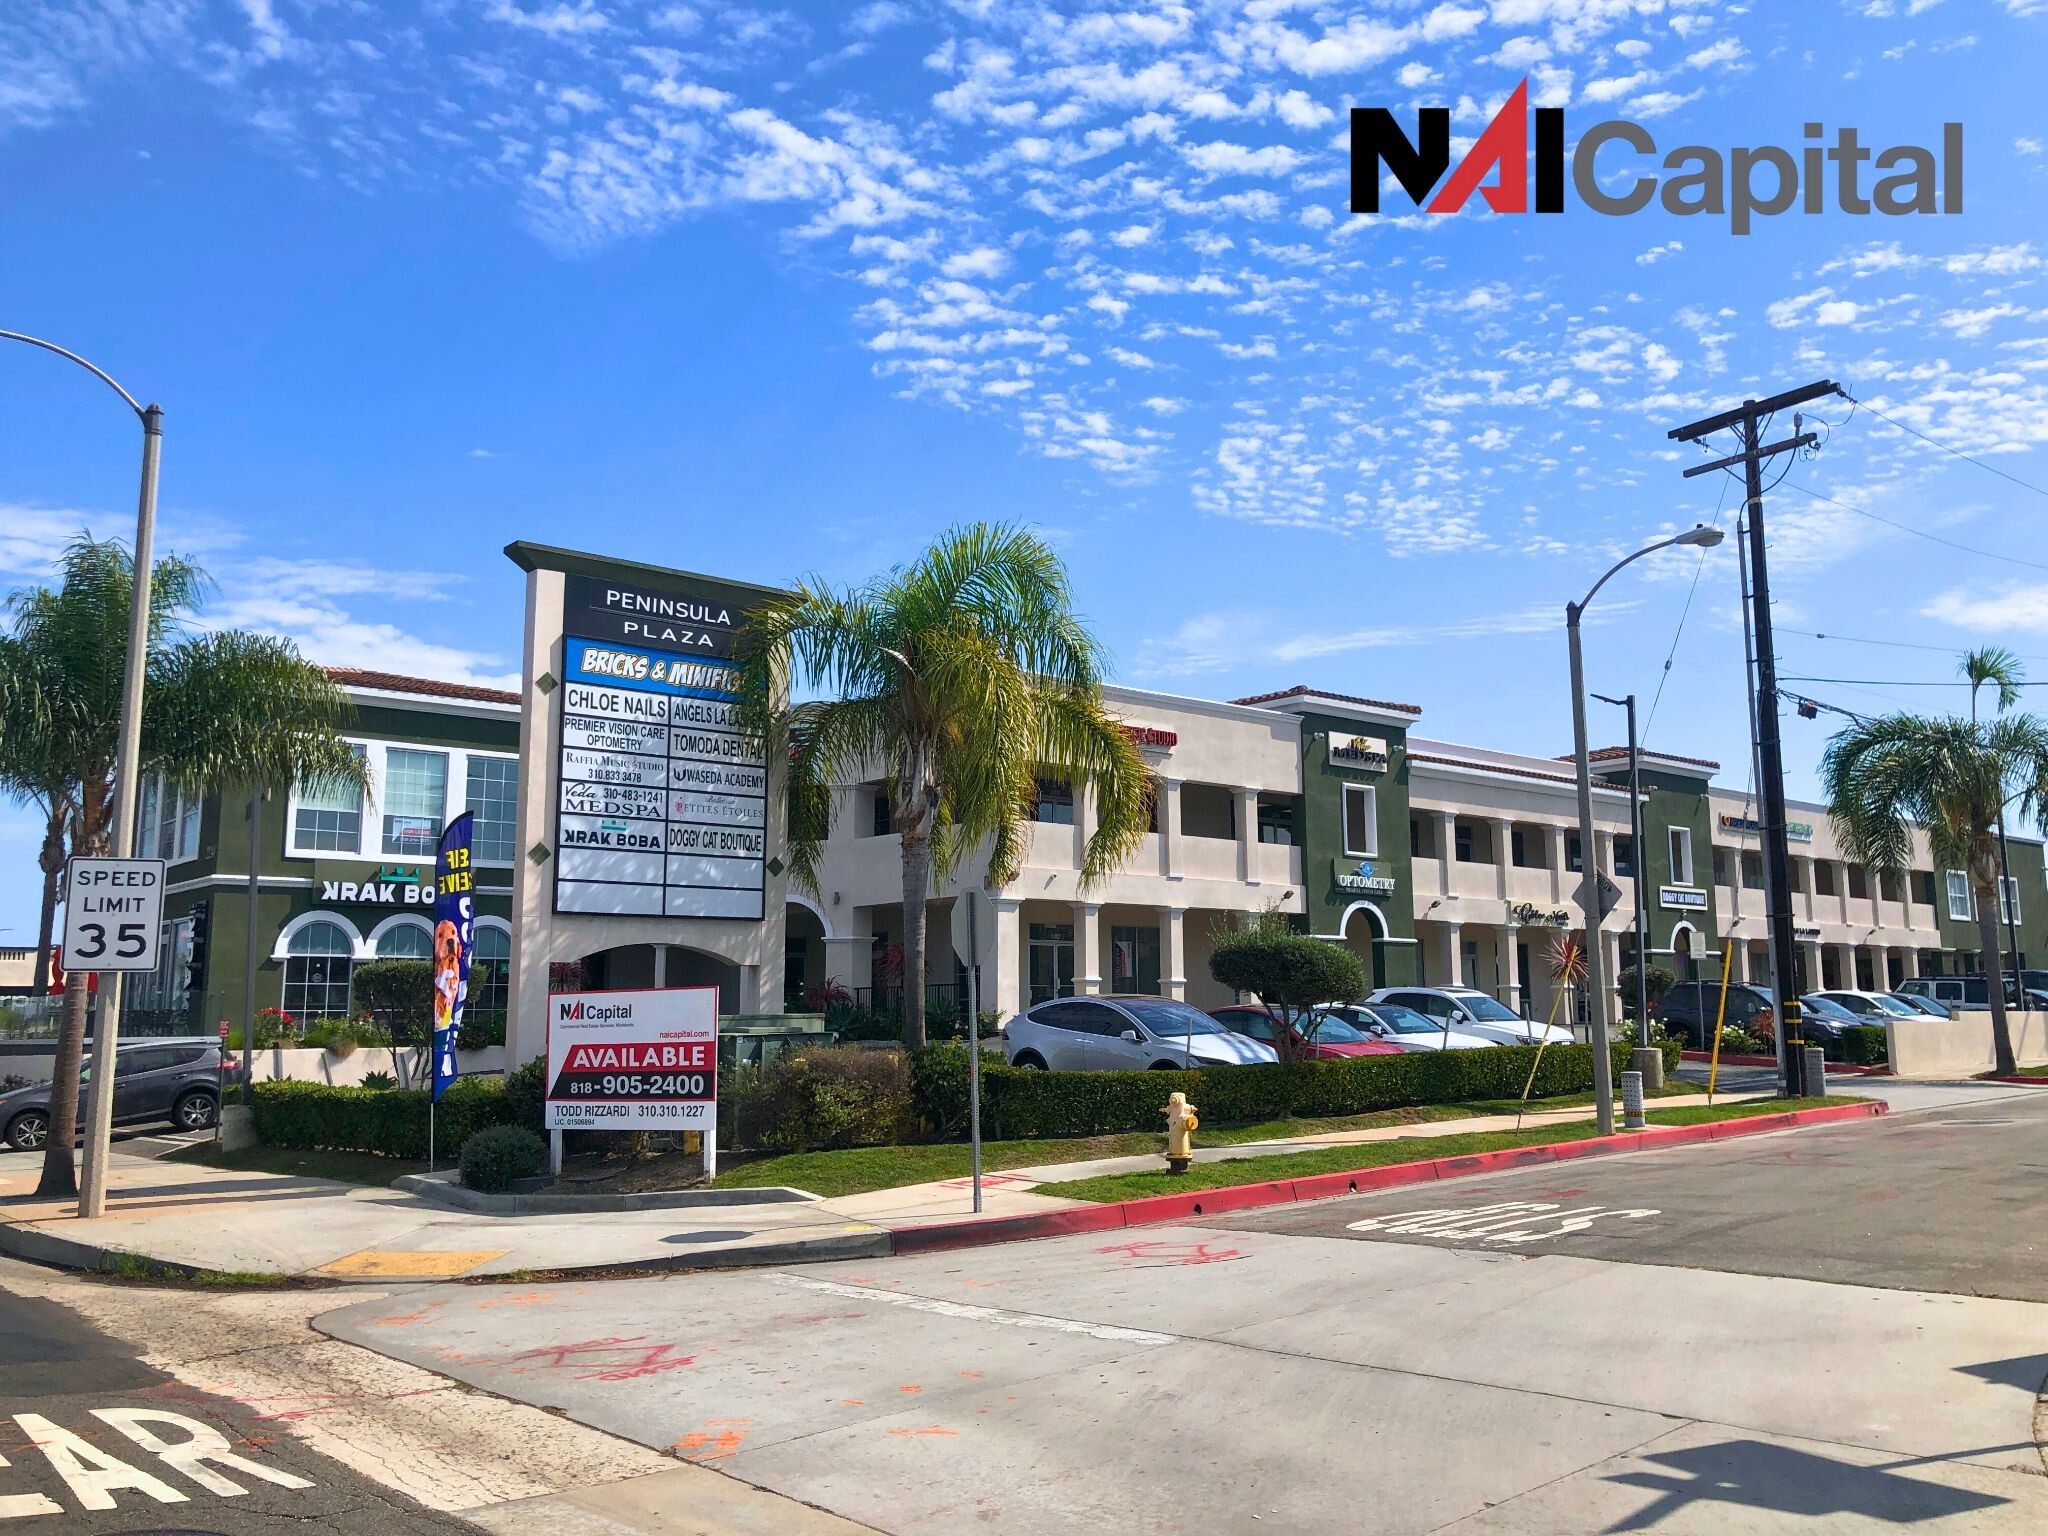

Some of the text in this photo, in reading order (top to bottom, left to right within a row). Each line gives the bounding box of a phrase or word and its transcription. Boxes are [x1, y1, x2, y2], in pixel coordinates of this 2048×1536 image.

[606, 589, 731, 626] PENINSULA
[624, 621, 714, 648] PLAZA
[582, 648, 745, 693] BRICKS & MINIFIG
[568, 689, 666, 718] CHLOE NAILS
[674, 703, 712, 724] ANGELS
[714, 708, 727, 726] LA
[564, 718, 665, 740] PREMIER VISION CARE
[1145, 728, 1178, 746] STUDIO
[587, 734, 643, 751] OPTOMETRY
[674, 733, 763, 760] TOMODA DENTAL
[566, 752, 598, 766] RAFFIA
[601, 755, 630, 768] MUSIC
[622, 772, 642, 783] 3478
[687, 769, 764, 789] WASEDA ACADEMY
[565, 782, 663, 804] Veda 310-483-1241
[565, 799, 662, 818] MEDSPA
[676, 802, 764, 819] PETITES ÉTOILES
[564, 829, 661, 848] KRAK BOBA
[669, 828, 762, 852] DOGGY CAT BOUTIQUE
[77, 870, 157, 887] SPEED
[1338, 874, 1395, 889] OPTOMETRY
[321, 881, 435, 905] KRAK BO
[1662, 891, 1677, 903] DOGGY
[1685, 893, 1705, 904] BOUTIQUE
[82, 897, 146, 913] LIMIT
[75, 923, 147, 959] 35
[560, 999, 632, 1022] NAI Capital
[659, 1030, 709, 1039] naicapital.com
[573, 1046, 705, 1068] AVAILABLE
[570, 1074, 704, 1095] 818-905-2400
[555, 1105, 705, 1117] TODD RIZZARDI 310.310.1227
